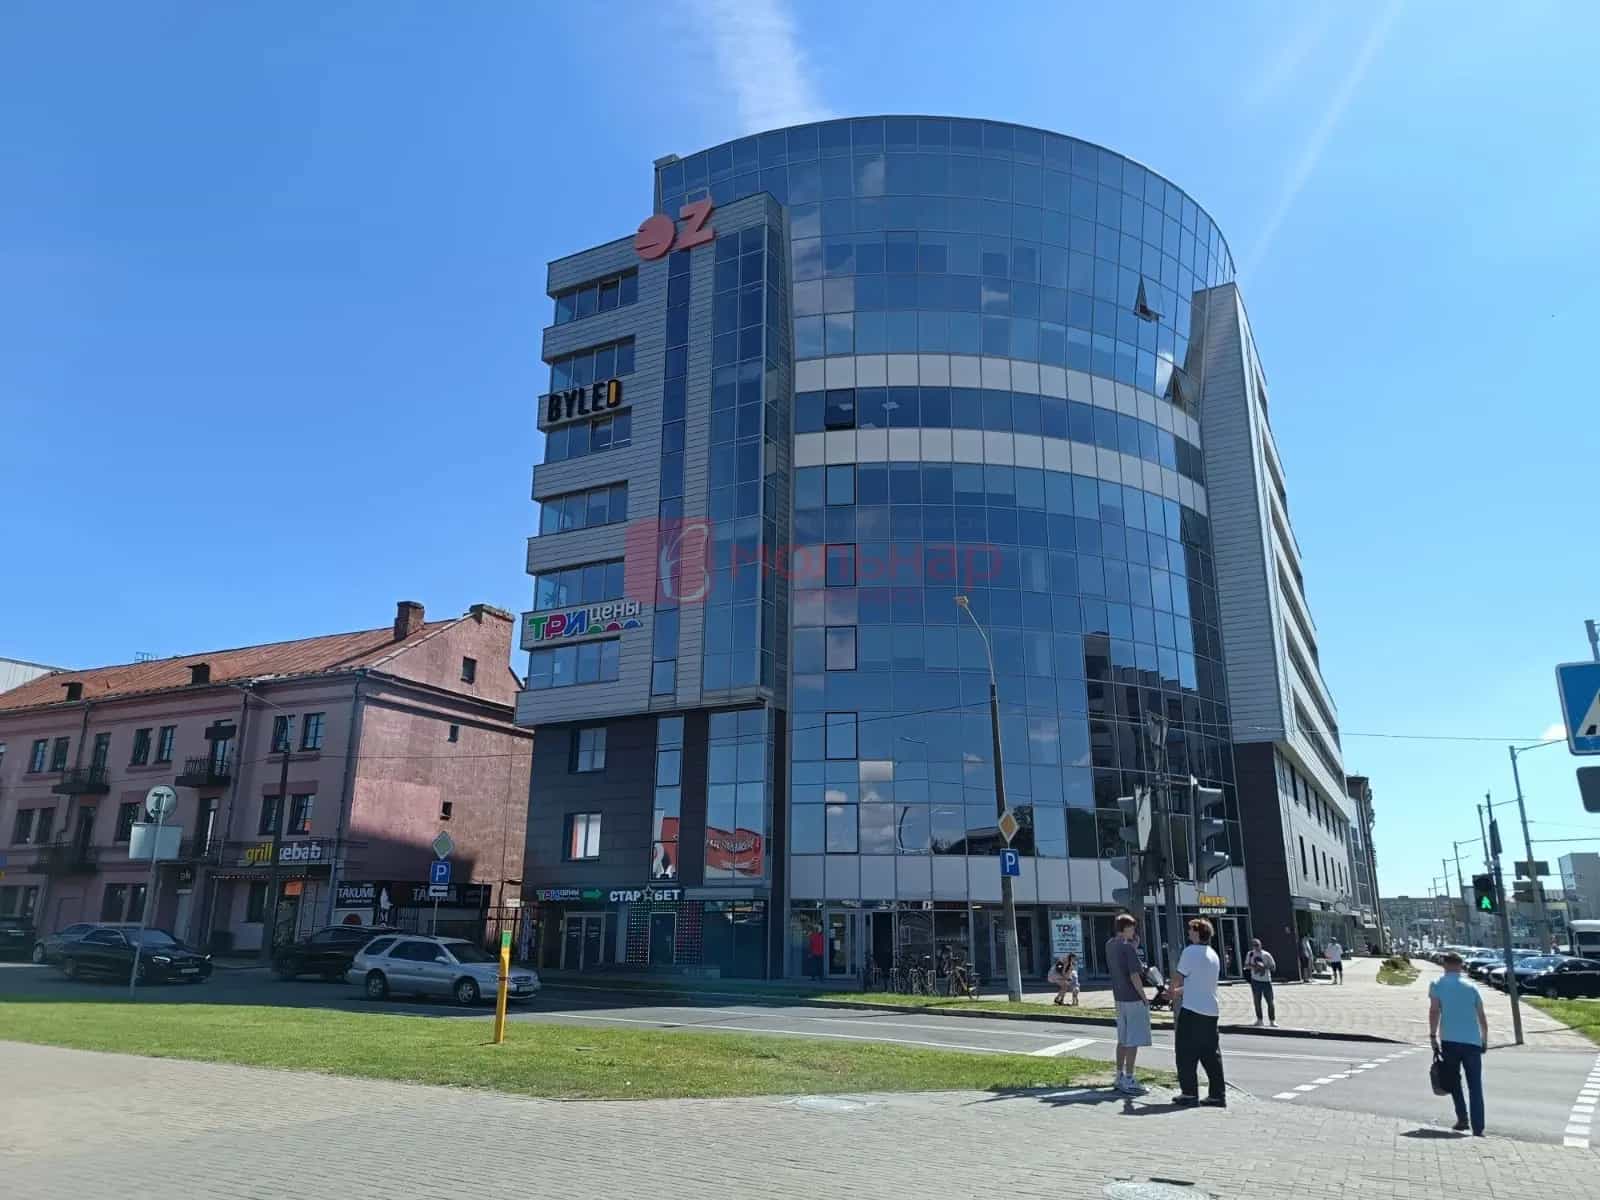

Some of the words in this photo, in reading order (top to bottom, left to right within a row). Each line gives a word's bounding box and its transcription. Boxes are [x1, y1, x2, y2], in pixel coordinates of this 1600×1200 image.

[547, 379, 622, 422] BYLED
[527, 610, 588, 640] ТРИ
[589, 600, 641, 623] цены
[245, 842, 272, 864] grill
[1005, 852, 1016, 873] P
[435, 864, 447, 881] P
